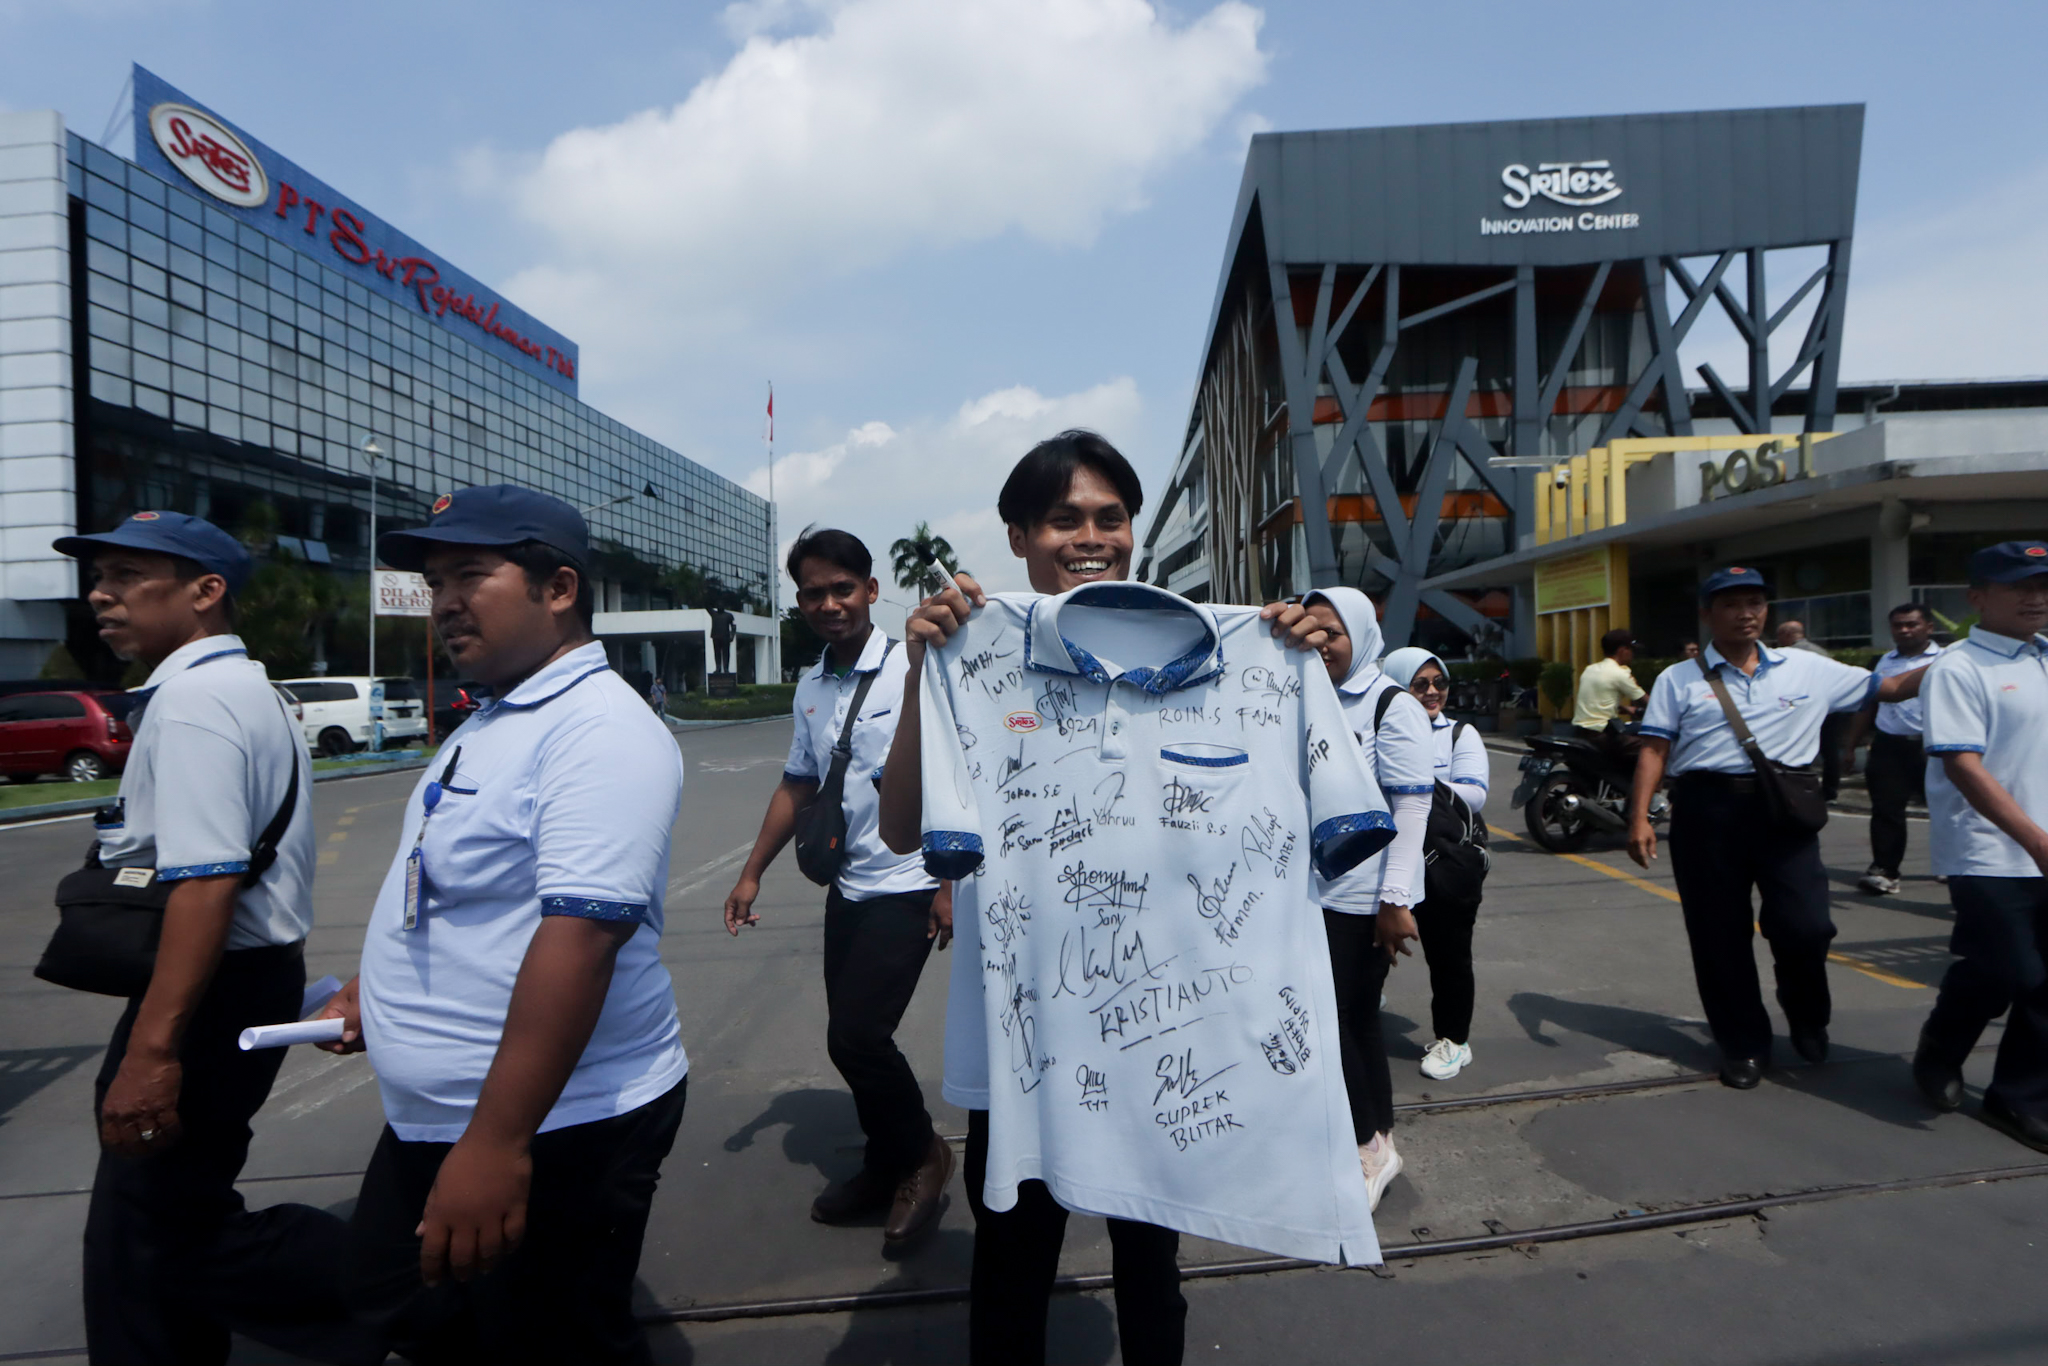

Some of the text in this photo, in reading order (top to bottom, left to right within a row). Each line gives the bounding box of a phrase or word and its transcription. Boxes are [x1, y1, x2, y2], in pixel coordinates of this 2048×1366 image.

[1481, 212, 1640, 235] INNOVATION CENTER
[275, 181, 325, 236] PT
[329, 207, 395, 281] Sri
[400, 257, 485, 326] Rejeki
[546, 345, 575, 380] Tbk
[1699, 439, 1786, 503] POS
[1100, 962, 1254, 1042] KRISTIANTO
[1169, 1113, 1245, 1152] BLITAR
